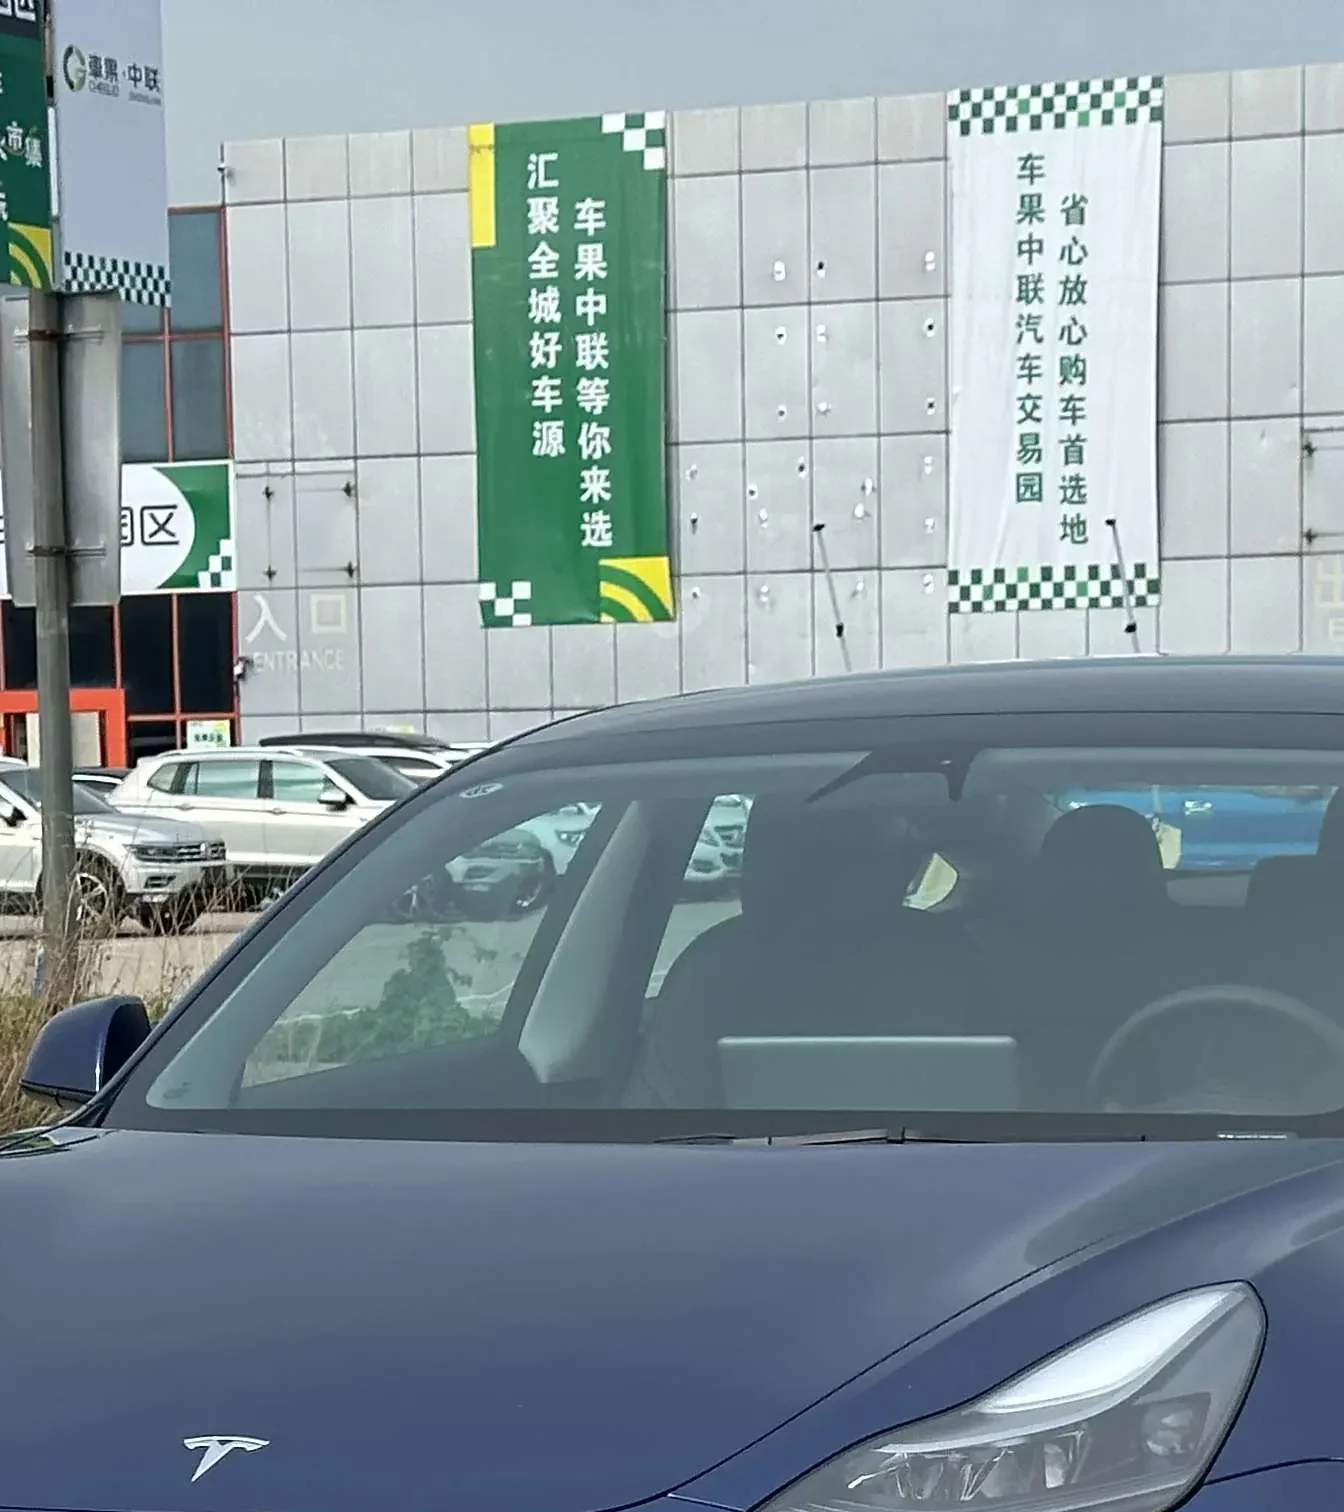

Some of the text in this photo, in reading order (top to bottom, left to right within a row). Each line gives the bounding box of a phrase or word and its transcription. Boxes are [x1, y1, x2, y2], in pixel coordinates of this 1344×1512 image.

[527, 152, 566, 458] 汇聚全城好车源
[573, 197, 613, 548] 车果中联等你来选
[1015, 152, 1045, 503] 车果中联汽车交易园
[1058, 193, 1089, 546] 省心放心购车首选地
[244, 593, 348, 644] 入口
[252, 648, 345, 673] ENTRANCE
